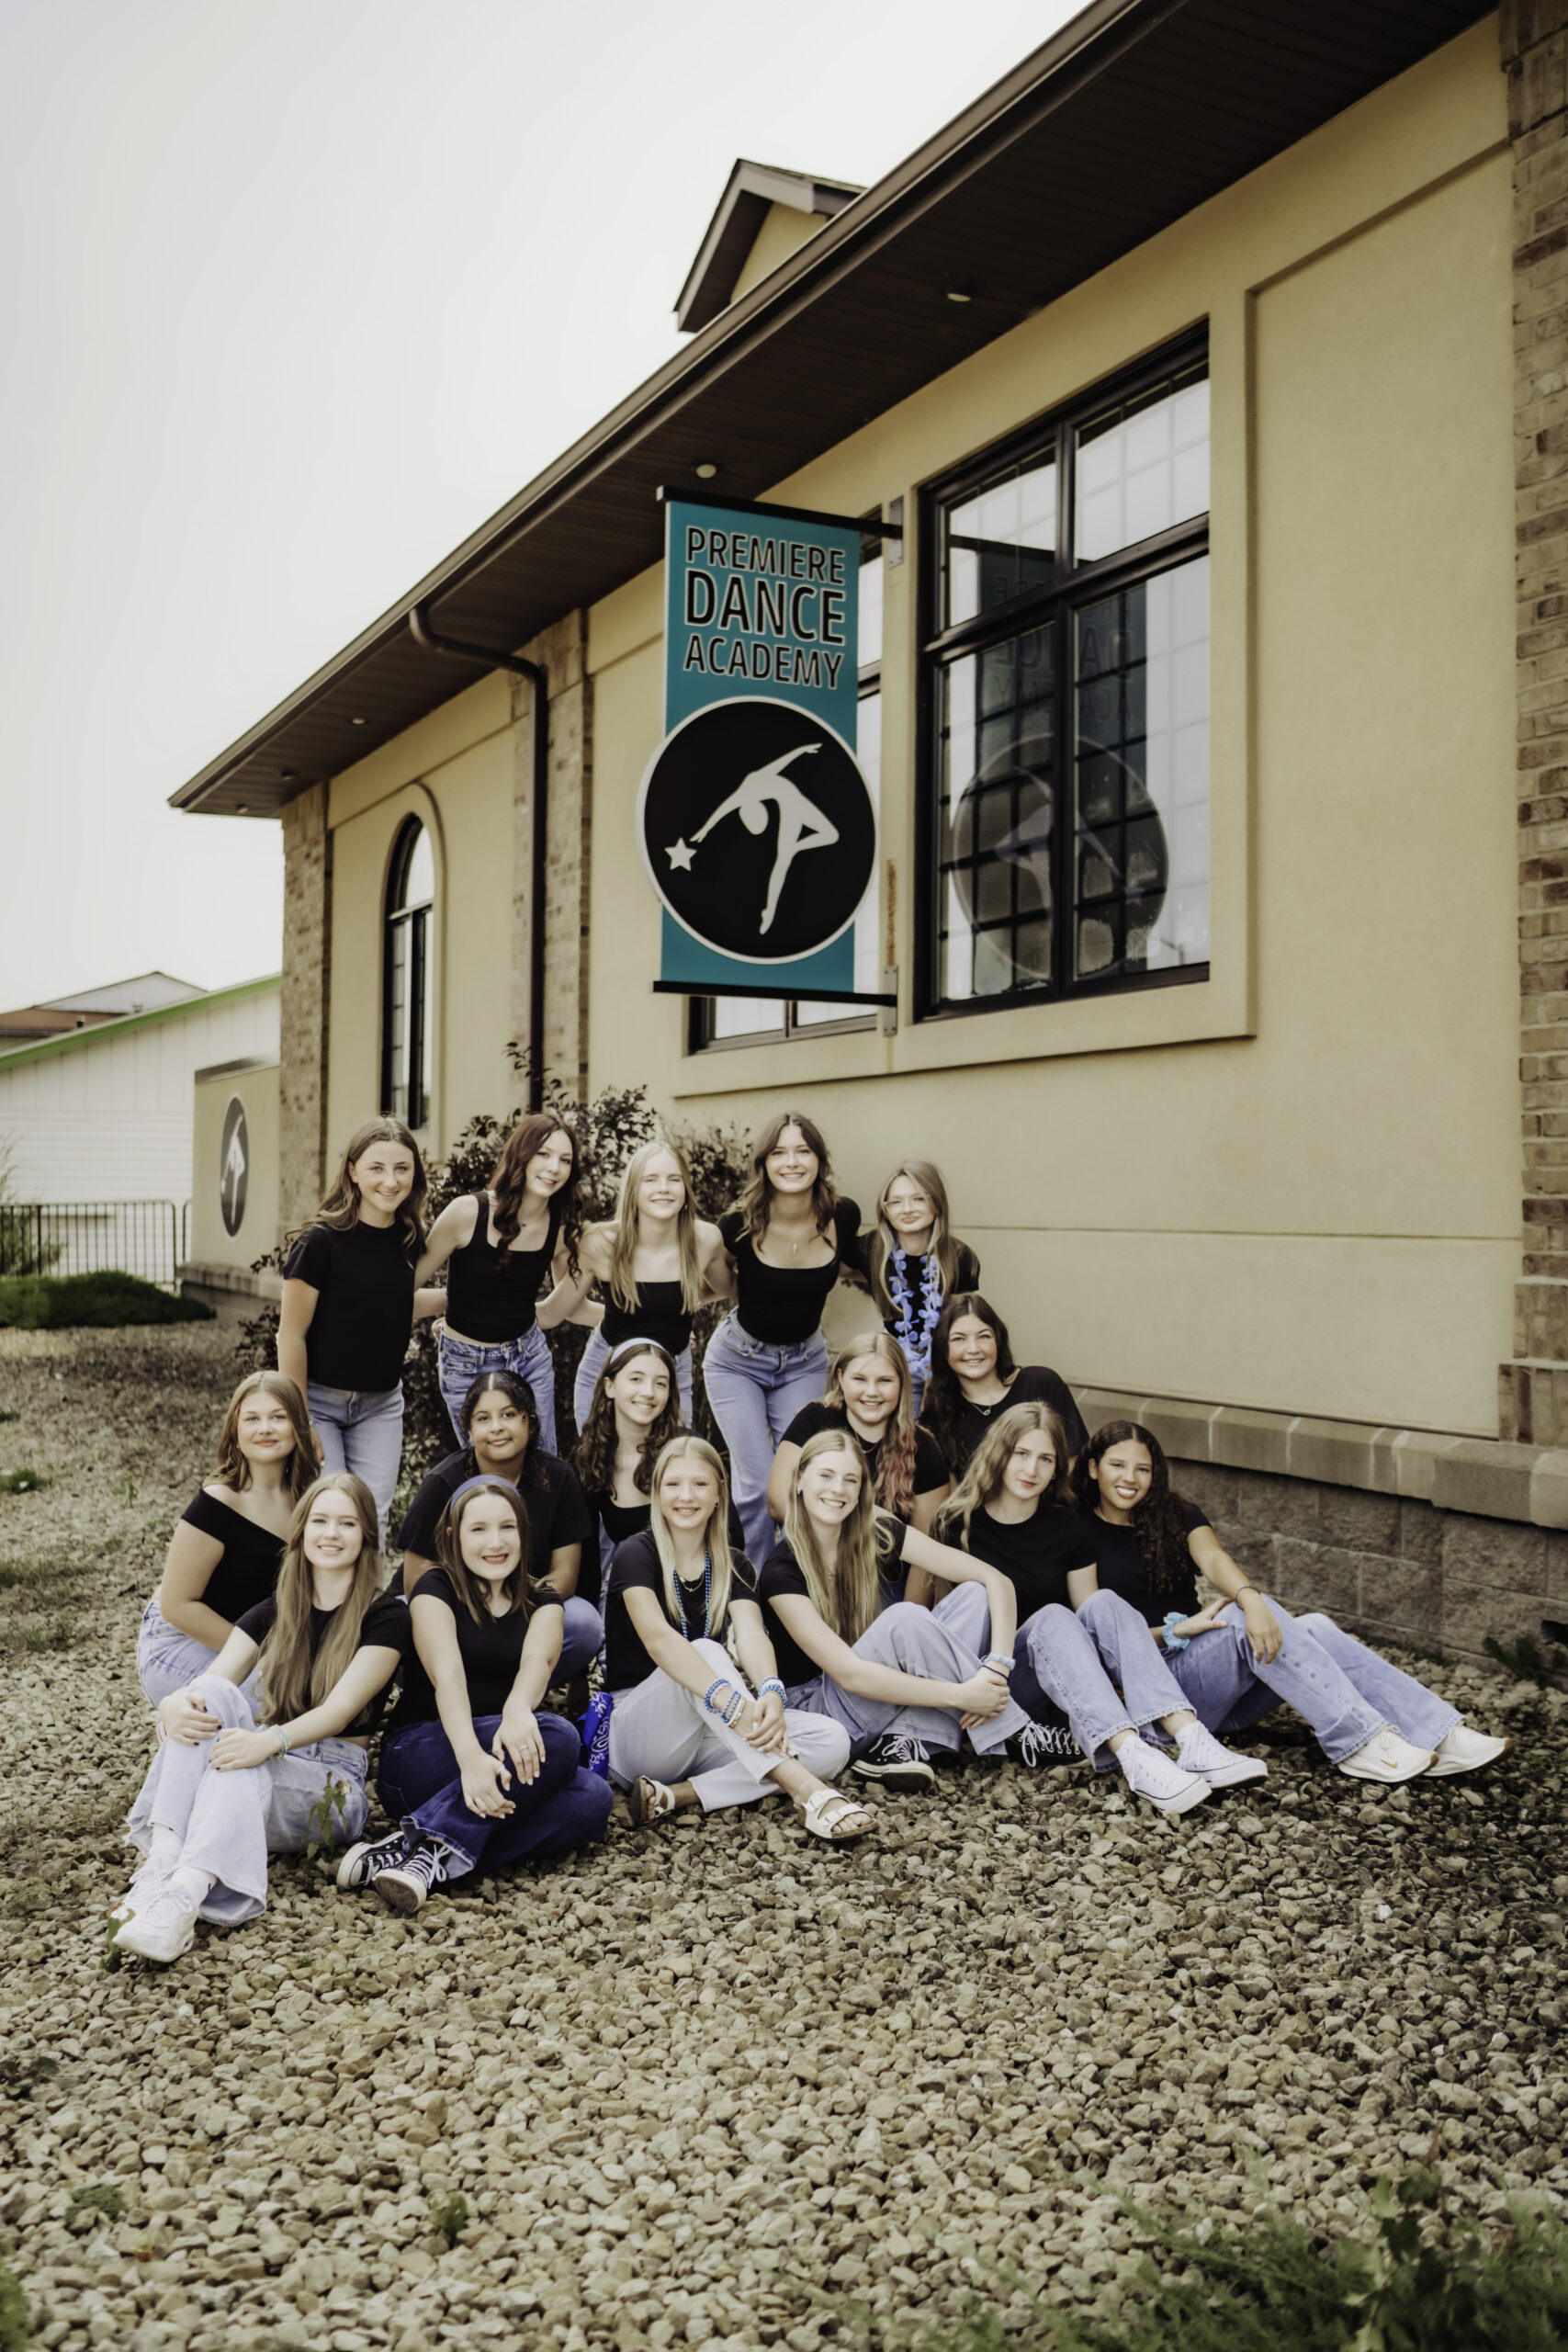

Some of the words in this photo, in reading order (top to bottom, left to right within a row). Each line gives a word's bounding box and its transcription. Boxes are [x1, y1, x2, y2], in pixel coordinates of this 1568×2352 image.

[686, 526, 845, 585] PREMIERE
[684, 568, 845, 646] DANCE
[683, 634, 844, 689] ACADEMY
